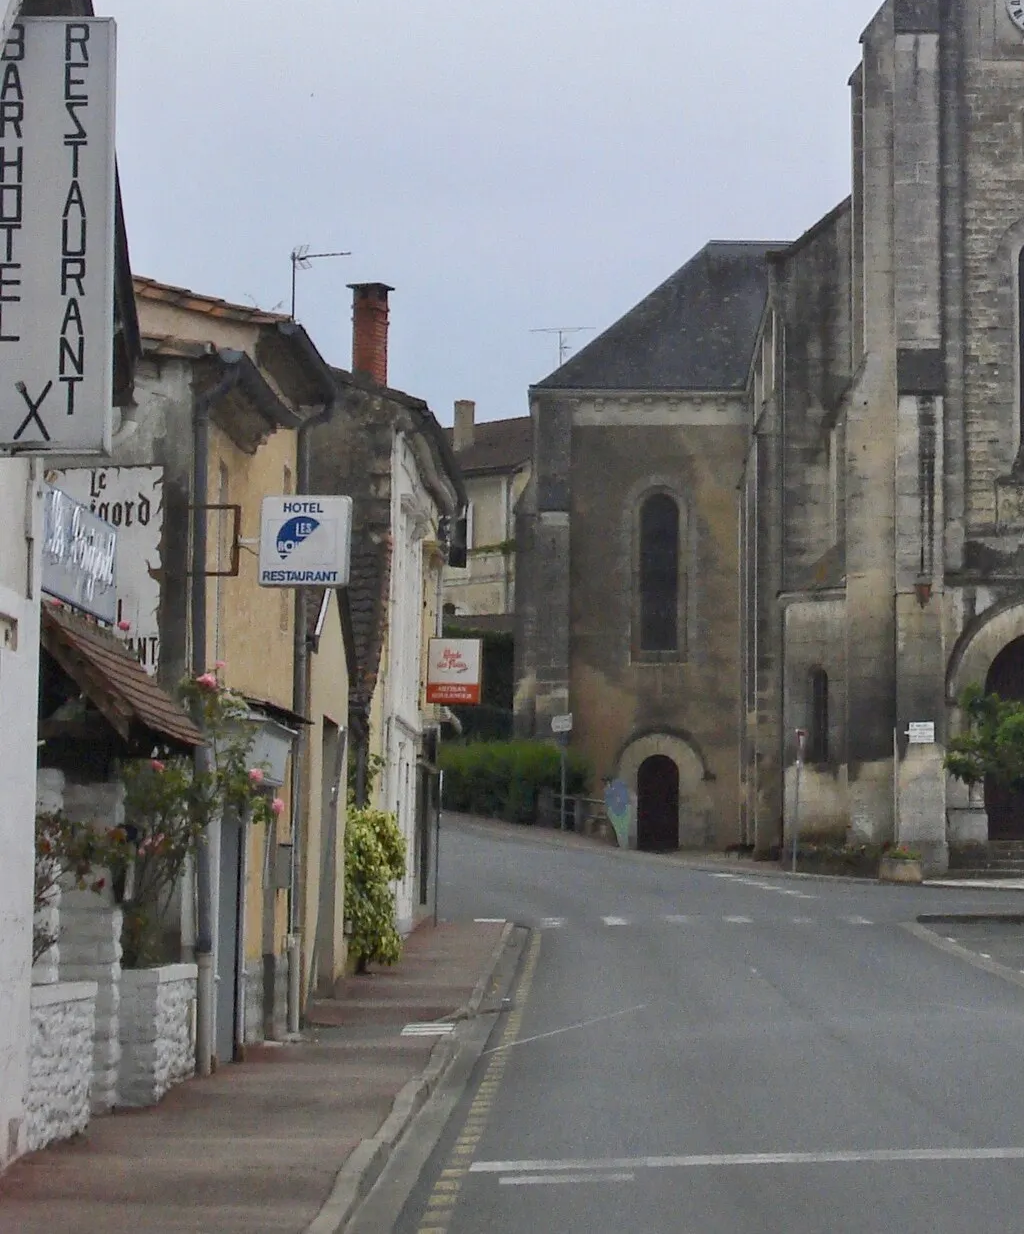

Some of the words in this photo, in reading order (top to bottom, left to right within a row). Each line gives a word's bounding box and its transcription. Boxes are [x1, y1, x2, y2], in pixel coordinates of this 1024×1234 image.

[0, 23, 25, 139] BAR
[59, 23, 90, 416] RESTAURANT
[0, 146, 24, 342] HOTEL
[90, 492, 151, 527] igord
[283, 502, 324, 514] HOTEL
[295, 521, 312, 538] LES
[262, 570, 339, 582] RESTAURANT
